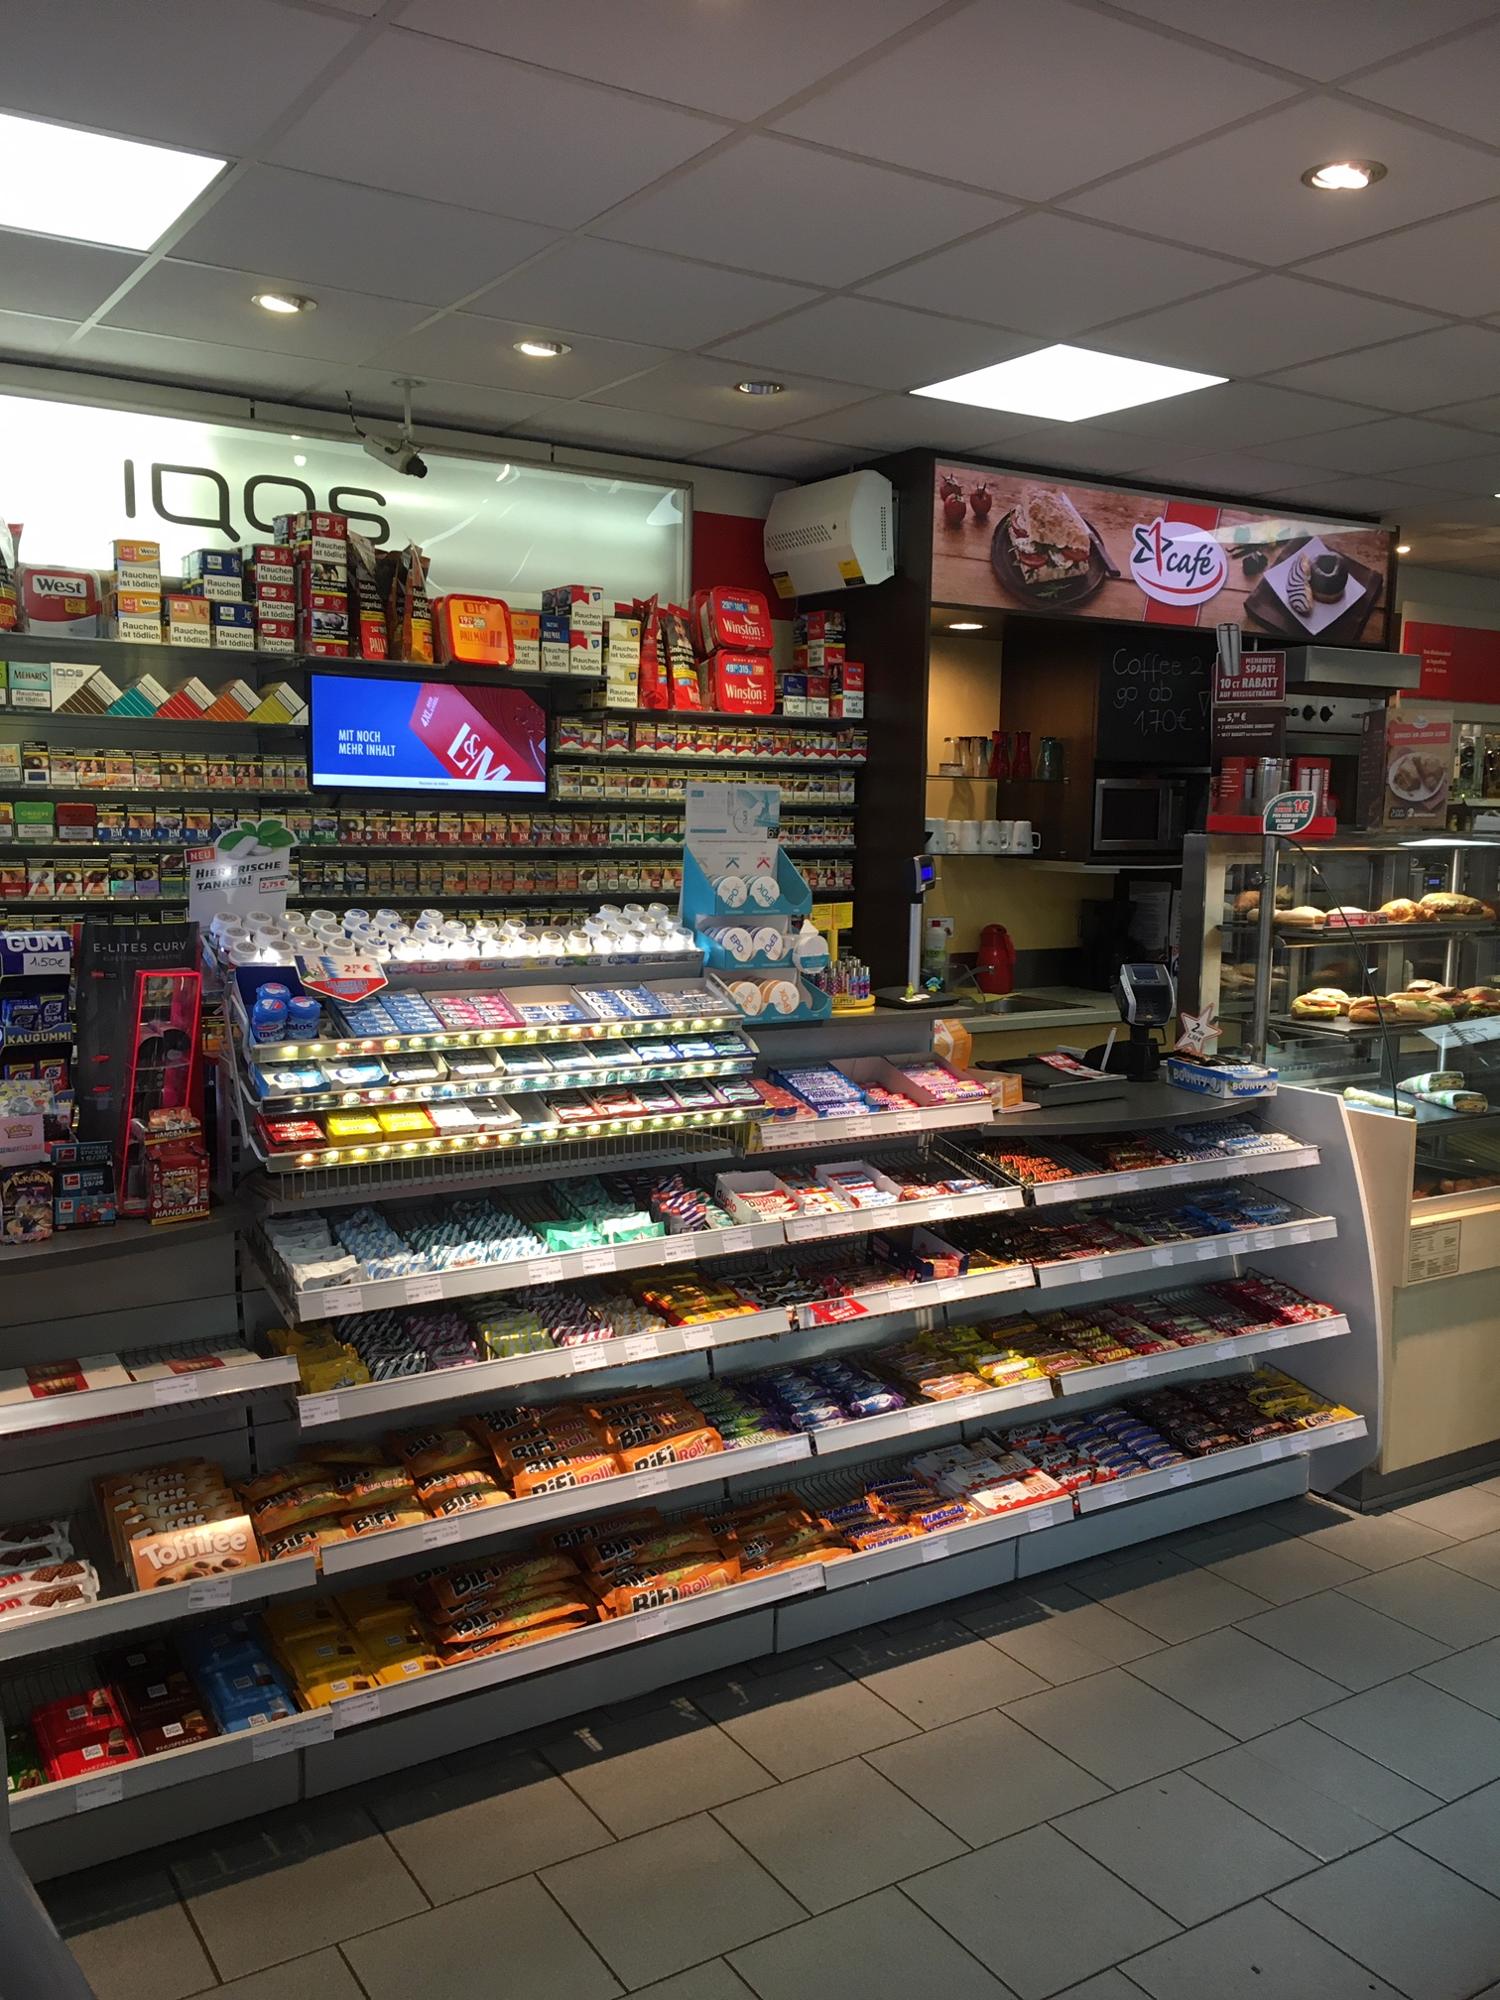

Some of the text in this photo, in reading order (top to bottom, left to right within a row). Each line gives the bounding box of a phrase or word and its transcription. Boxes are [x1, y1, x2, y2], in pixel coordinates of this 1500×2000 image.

[124, 459, 391, 545] IQOS
[1166, 543, 1215, 586] café
[37, 577, 82, 595] West
[722, 617, 761, 637] Winston
[1112, 648, 1184, 683] Coffee
[1245, 664, 1276, 674] SPART!
[725, 683, 763, 701] Winston
[1220, 678, 1232, 689] 10
[1242, 677, 1279, 689] RABATT
[1113, 681, 1174, 710] go ab
[338, 729, 381, 742] MIT NOCH
[338, 742, 396, 757] MEHR INHALT
[447, 722, 511, 781] L&M
[190, 850, 211, 861] NEU
[7, 935, 64, 952] GUM
[93, 941, 187, 953] E-LITES CURV
[8, 1031, 71, 1045] KAUGUMMI
[155, 1205, 206, 1218] HANDBALL
[618, 1422, 663, 1450] BiFi
[441, 1490, 483, 1515] BiFi
[353, 1510, 398, 1535] BiFi
[139, 1529, 248, 1571] Toffifee
